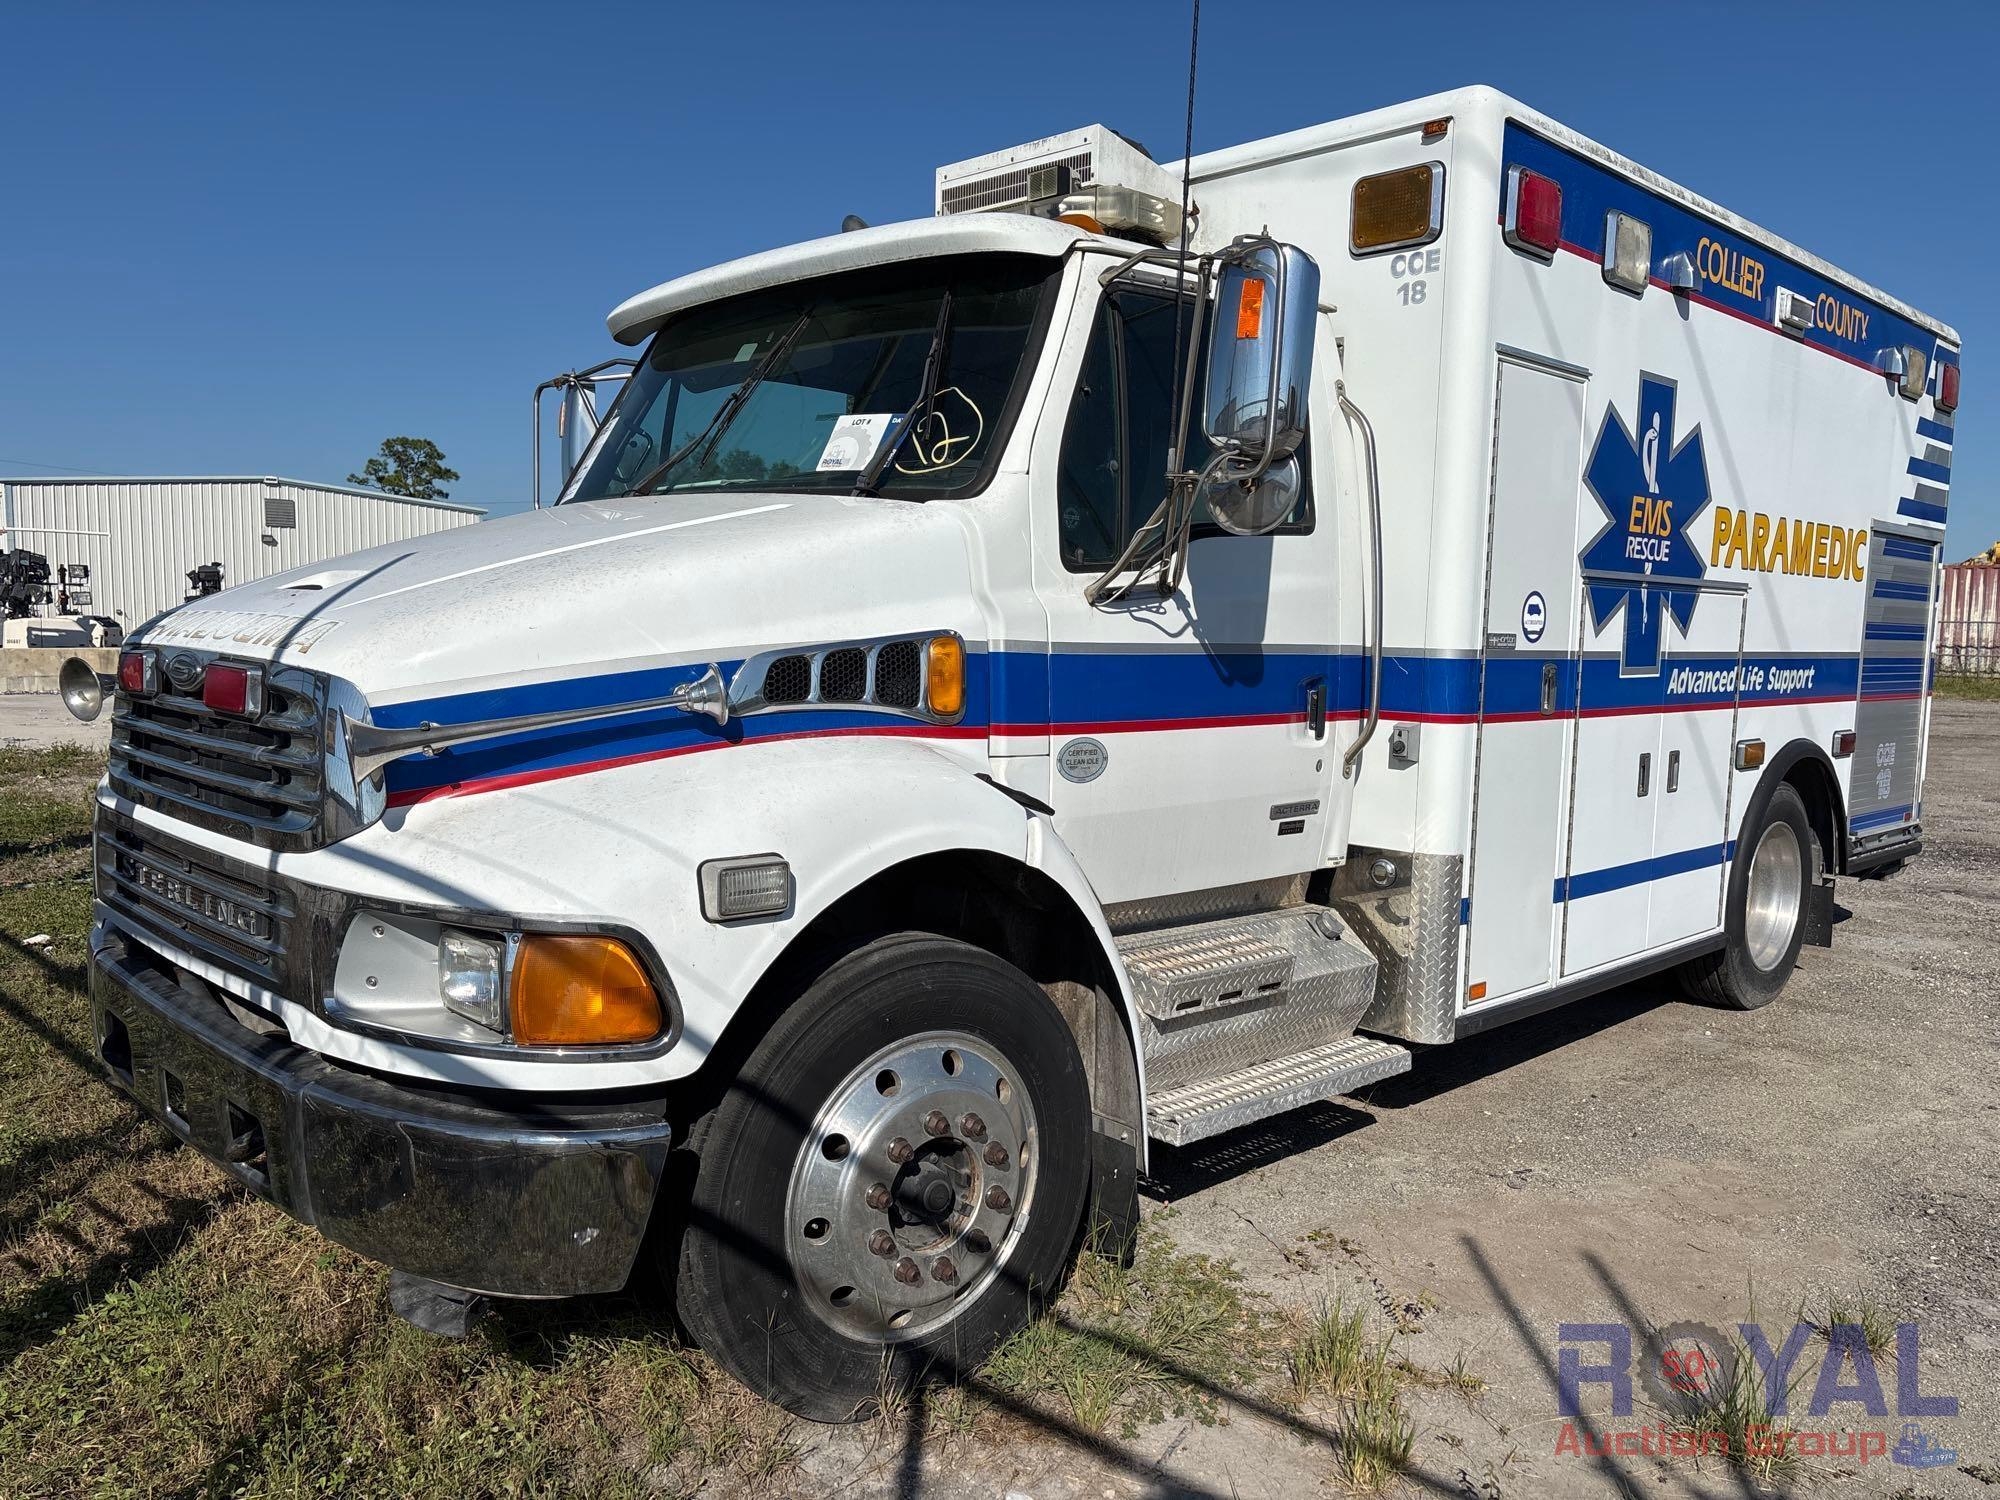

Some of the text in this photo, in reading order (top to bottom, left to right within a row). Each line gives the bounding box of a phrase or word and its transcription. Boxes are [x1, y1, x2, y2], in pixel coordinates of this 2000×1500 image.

[1391, 248, 1441, 279] CCE
[1396, 279, 1427, 306] 18
[1696, 236, 1870, 344] COLLIER COUNTY
[851, 418, 866, 426] LOT
[910, 411, 970, 465] 12
[1628, 495, 1673, 537] EMS
[1625, 536, 1671, 562] RESCUE
[1710, 505, 1868, 583] PARAMEDIC
[1667, 665, 1816, 695] Advanced Life Support
[1065, 758, 1086, 766] CLEAN
[1067, 749, 1099, 757] CERTIFIED
[1276, 801, 1319, 814] ACTERRA
[121, 857, 257, 935] STERLING
